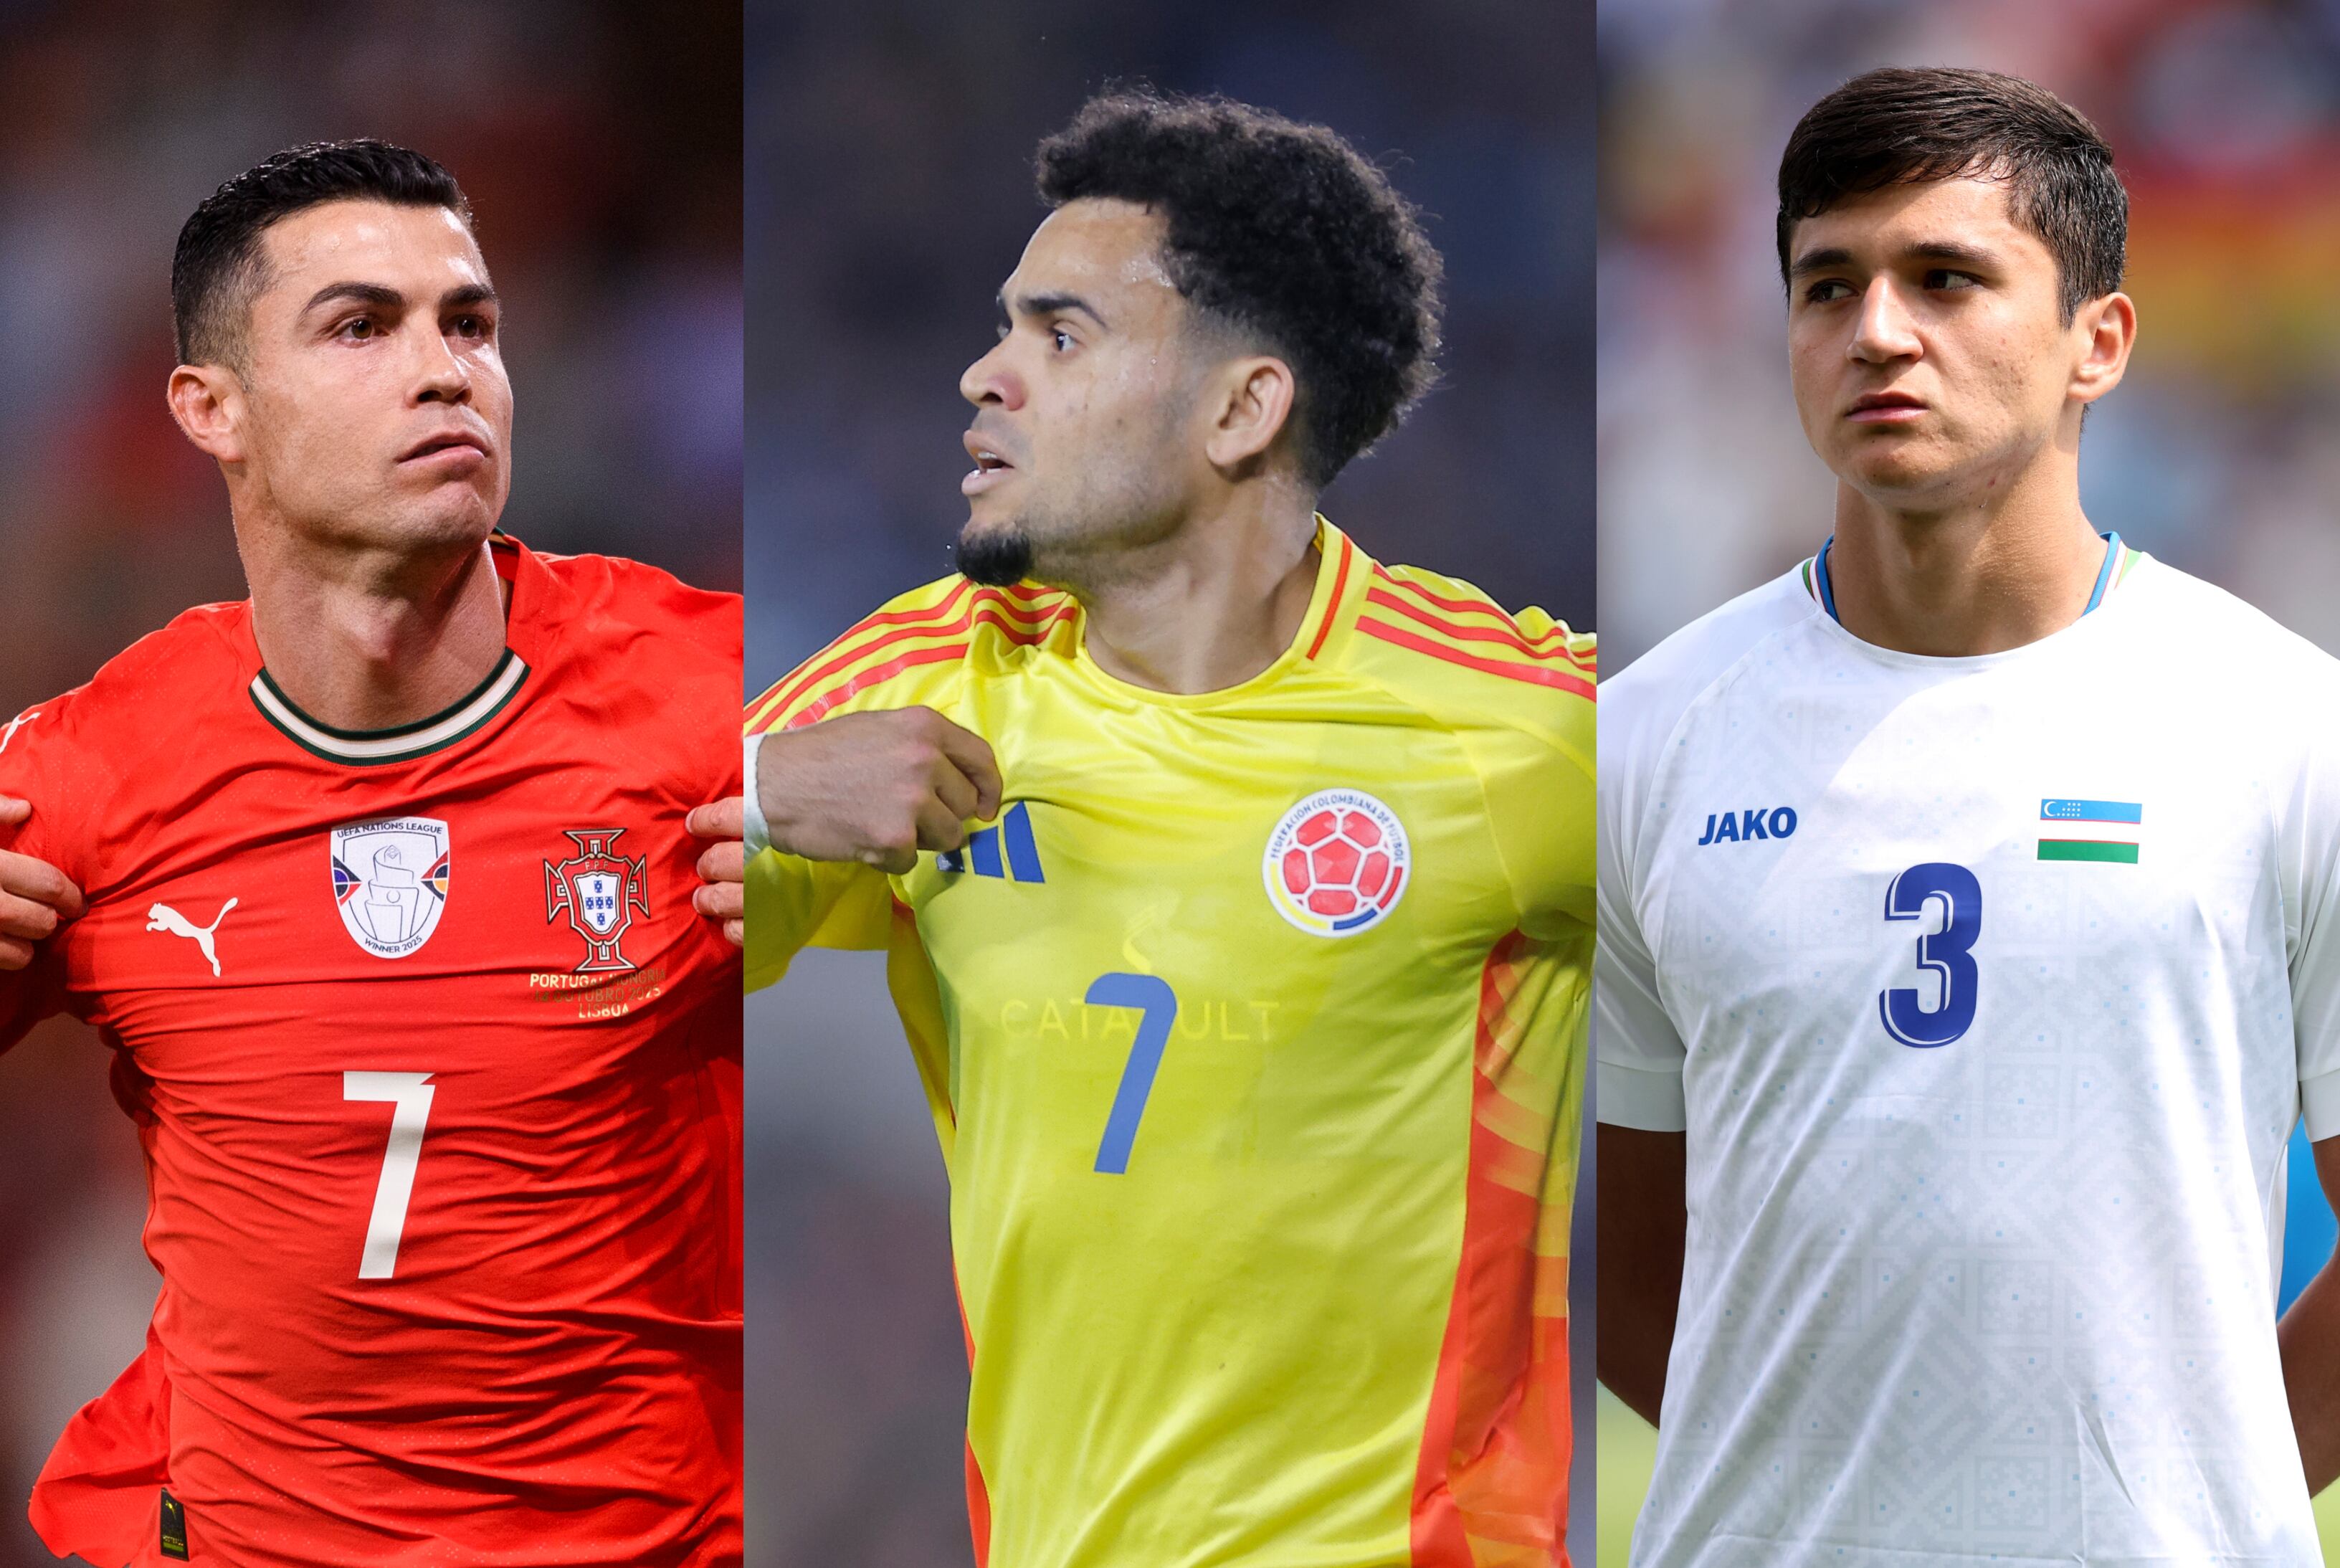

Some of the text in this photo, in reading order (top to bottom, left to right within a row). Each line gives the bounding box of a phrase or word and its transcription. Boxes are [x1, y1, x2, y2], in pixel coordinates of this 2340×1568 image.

[1311, 794, 1377, 814] COLOMBIANA
[1376, 812, 1390, 825] DE
[1698, 807, 1797, 846] JAKO
[337, 822, 443, 838] UEFA NATIONS LEAGUE
[364, 935, 422, 953] WINNER 2025
[1878, 862, 1982, 1049] 3
[578, 1003, 629, 1018] LISBOA
[629, 986, 662, 1001] 2025
[1001, 998, 1280, 1041] CATAULT
[1084, 971, 1177, 1175] 7
[343, 1070, 436, 1280] 7
